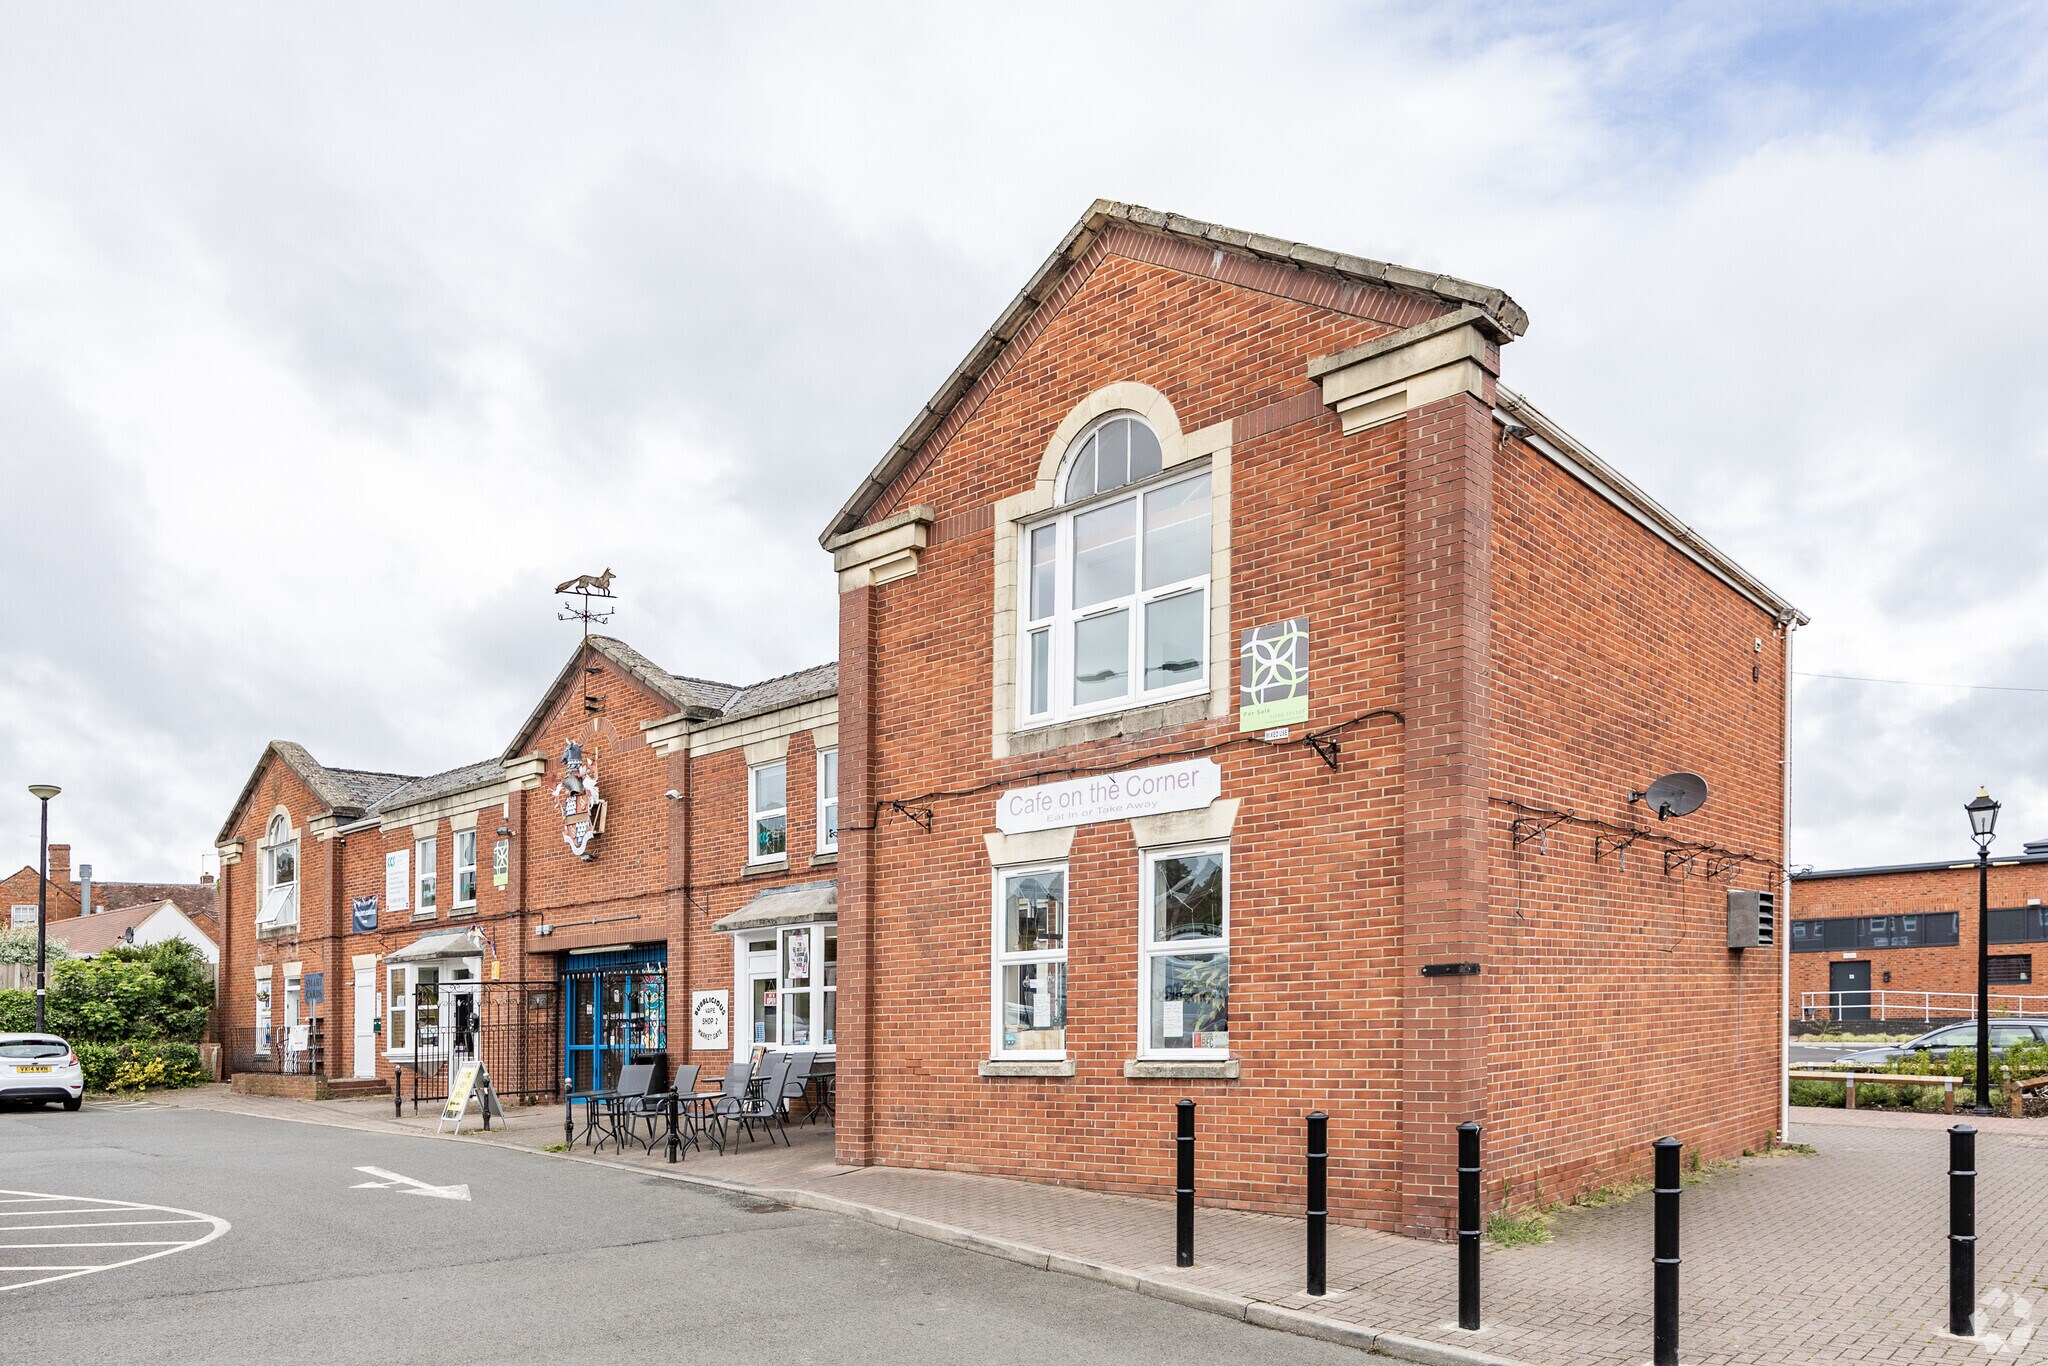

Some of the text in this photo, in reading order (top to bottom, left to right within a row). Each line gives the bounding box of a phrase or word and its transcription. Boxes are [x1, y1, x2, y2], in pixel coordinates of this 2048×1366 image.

[1010, 770, 1199, 816] Cafe on the Corner
[1047, 813, 1065, 822] Eat
[1069, 811, 1078, 819] In
[1097, 804, 1123, 815] Take
[1126, 800, 1158, 810] Away
[305, 978, 322, 987] SMART
[305, 989, 323, 999] CARDS
[694, 997, 726, 1016] BUBBLICIOUS
[702, 1017, 714, 1025] SHOP
